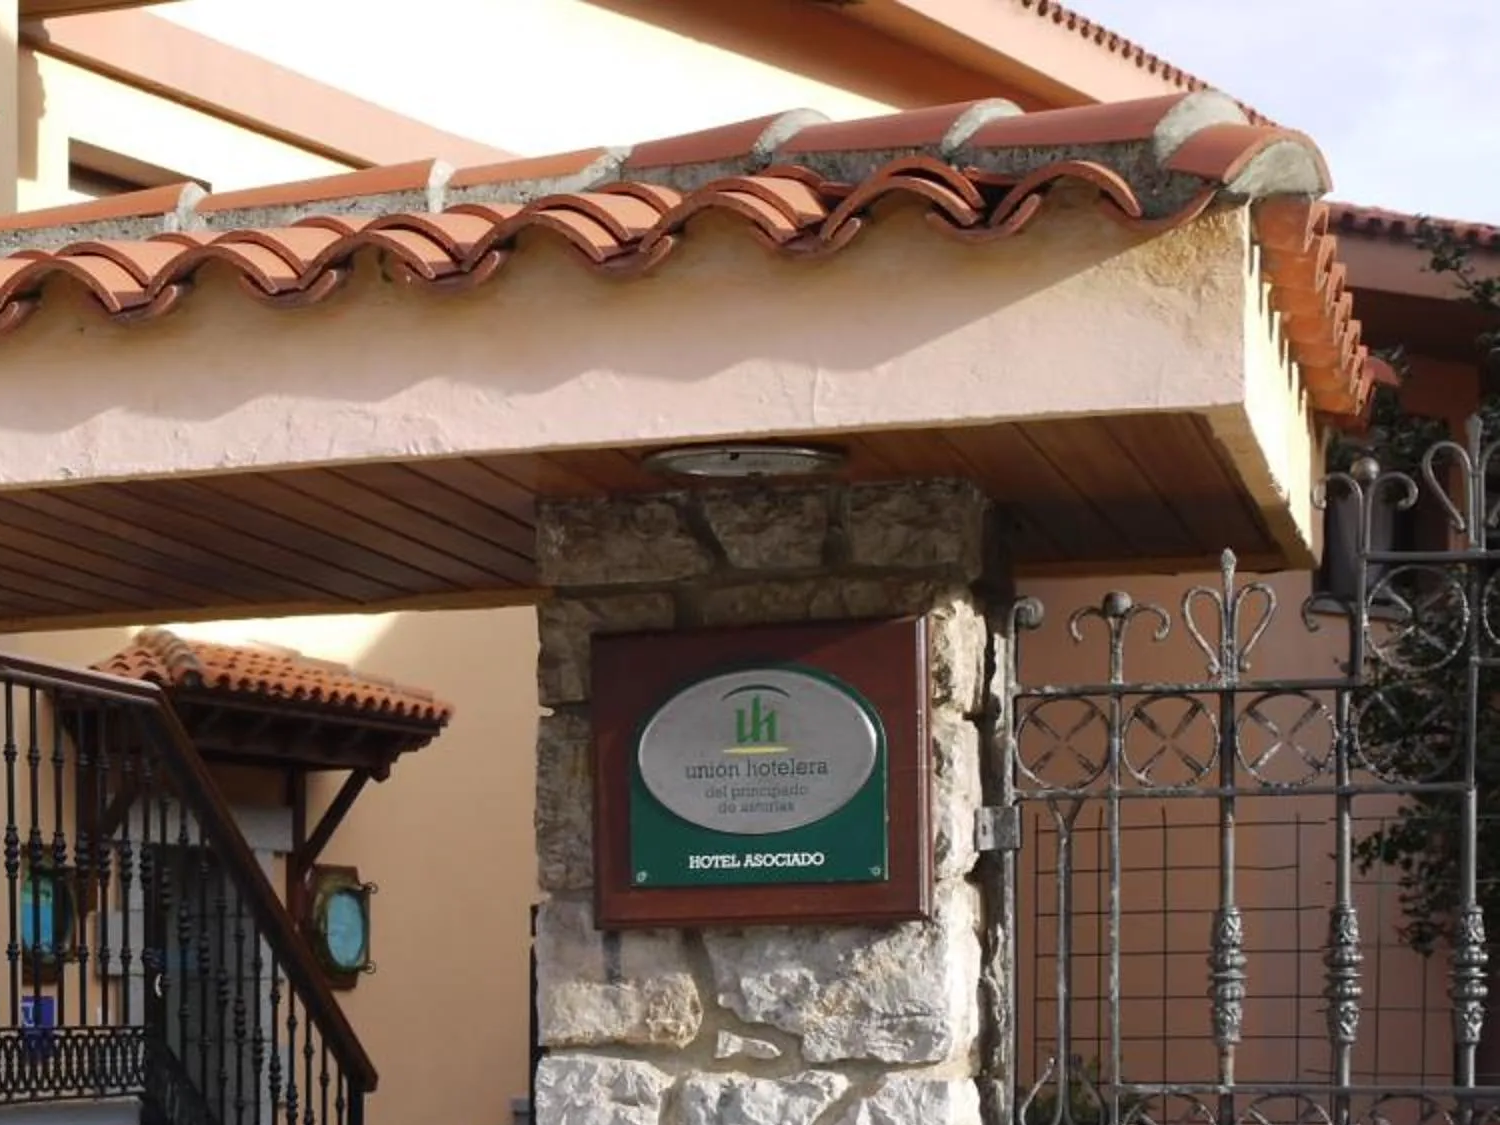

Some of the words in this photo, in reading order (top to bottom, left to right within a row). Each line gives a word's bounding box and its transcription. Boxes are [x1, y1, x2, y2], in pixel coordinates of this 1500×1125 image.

[746, 757, 829, 778] hotelera
[704, 785, 727, 799] del
[731, 783, 809, 801] principado
[689, 854, 741, 870] HOTEL
[743, 851, 825, 868] ASOCIADO
